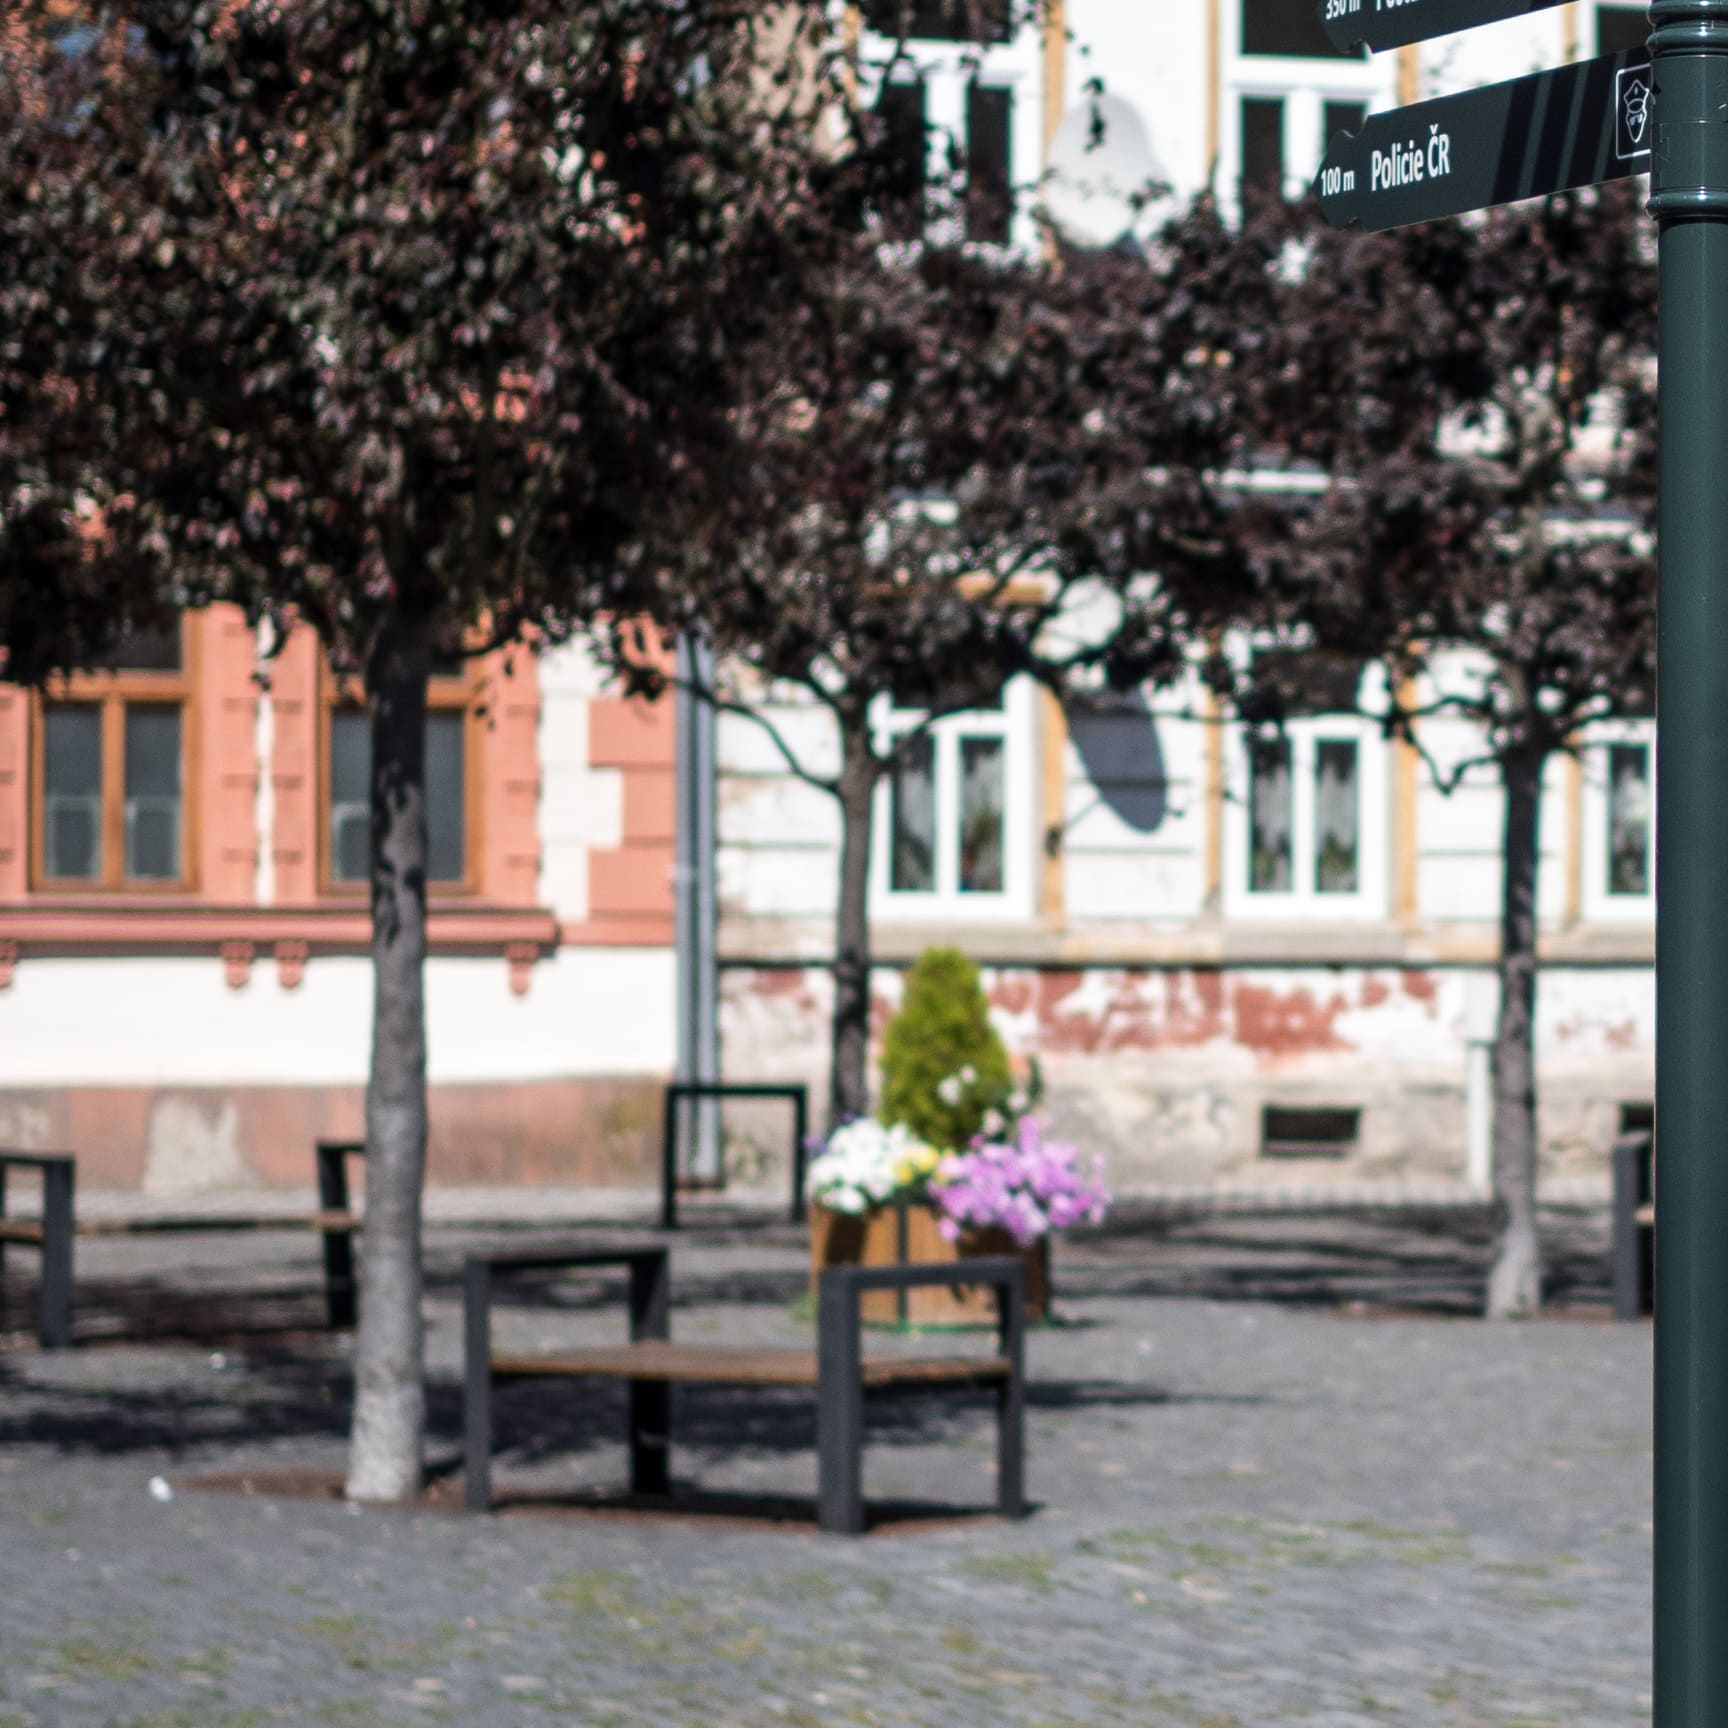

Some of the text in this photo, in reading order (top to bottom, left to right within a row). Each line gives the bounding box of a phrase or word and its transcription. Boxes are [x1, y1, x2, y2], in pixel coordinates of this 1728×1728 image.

[1320, 123, 1451, 197] 100 m Policie ČR
